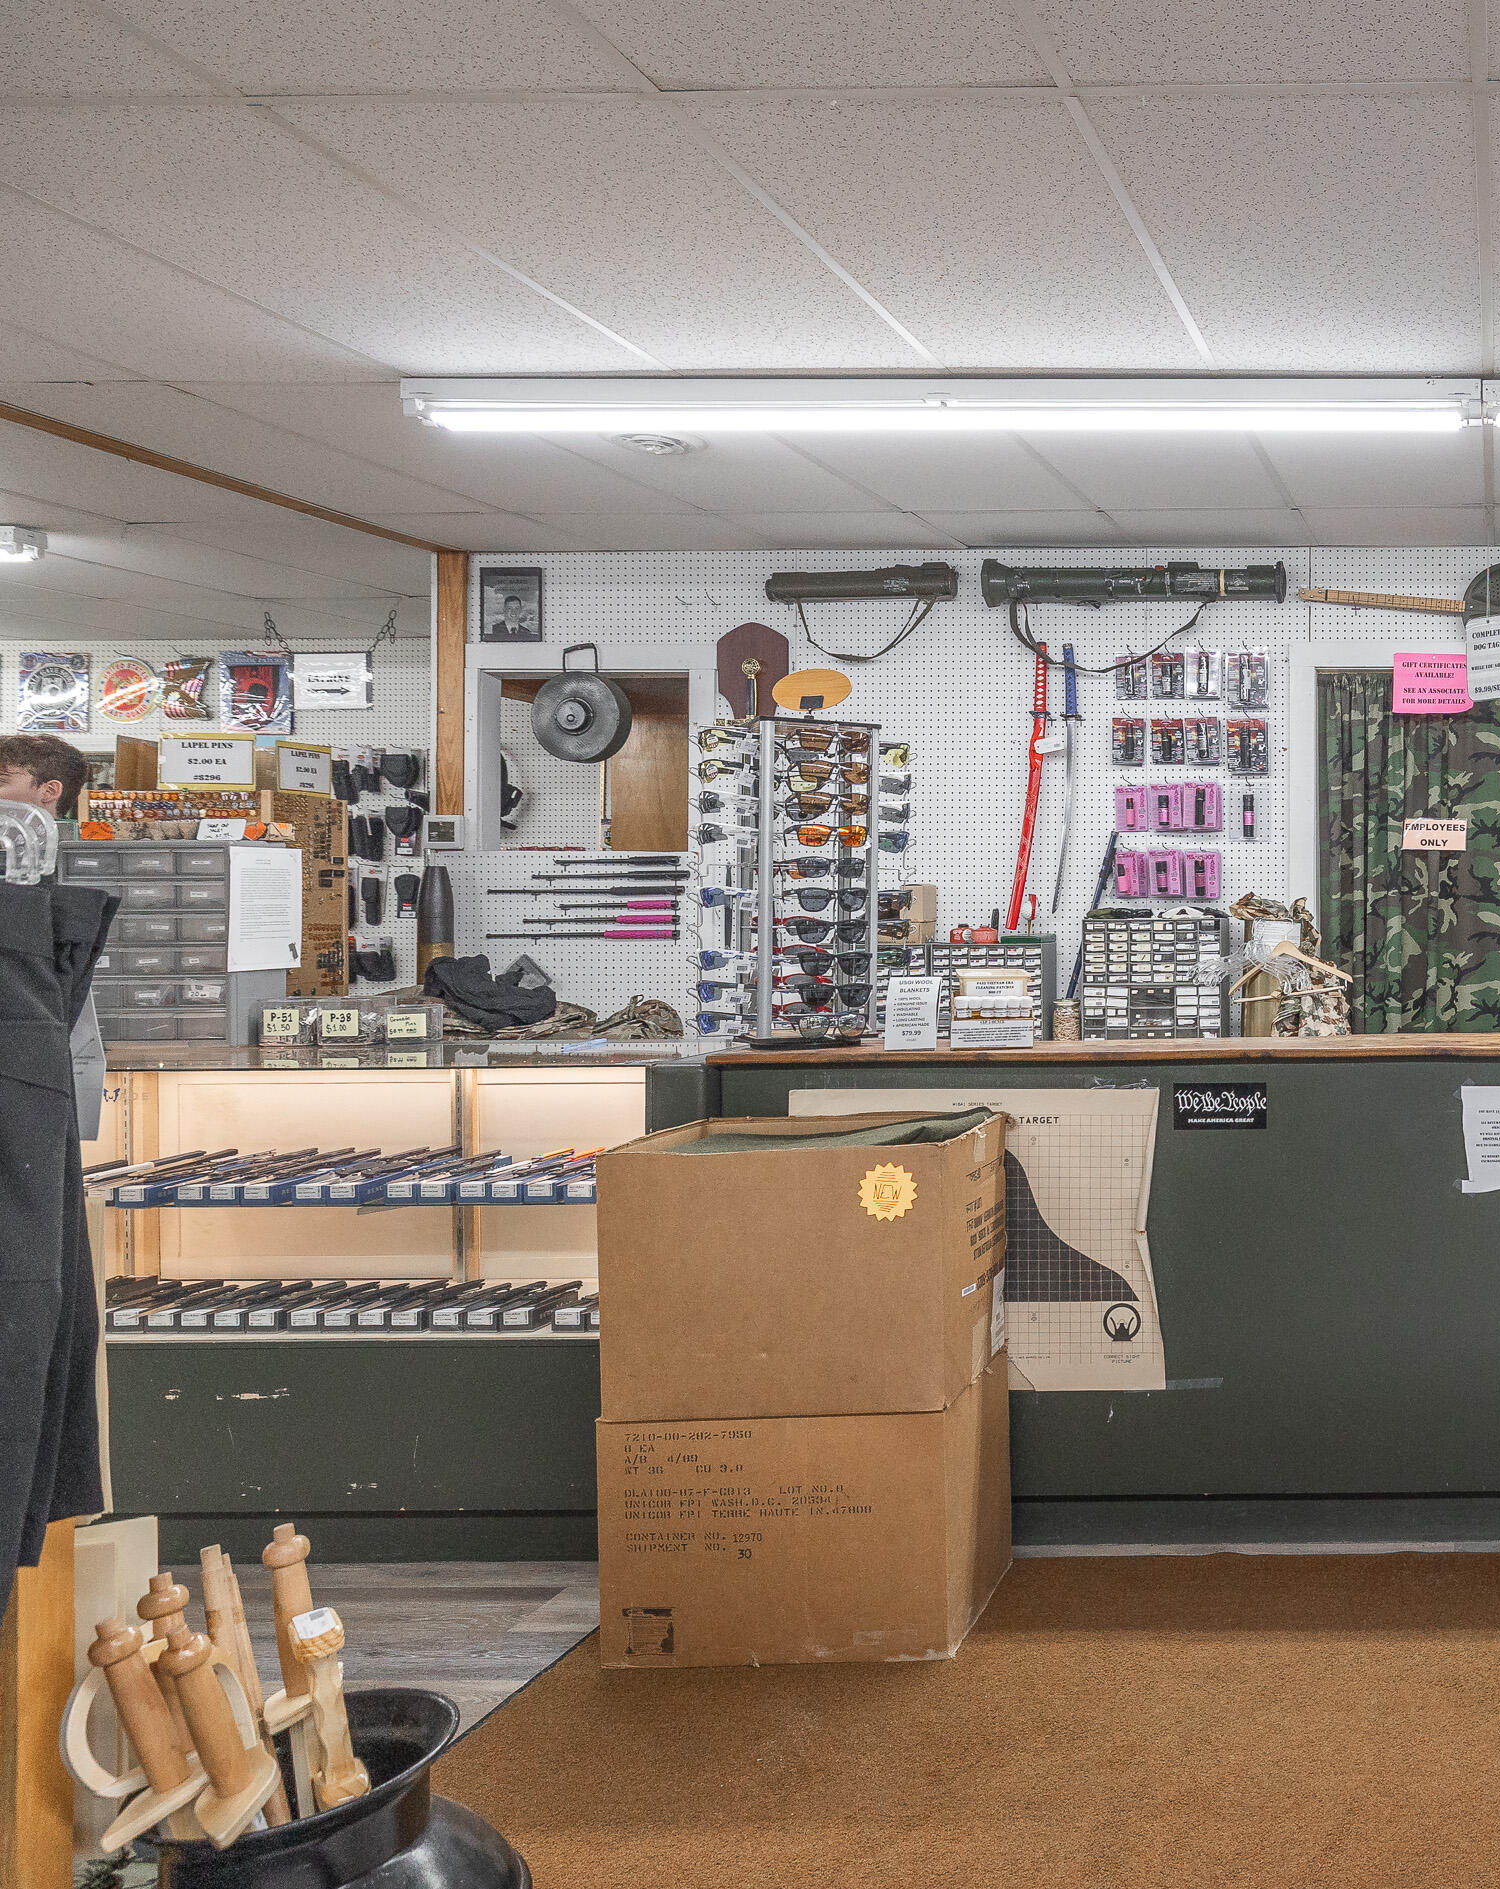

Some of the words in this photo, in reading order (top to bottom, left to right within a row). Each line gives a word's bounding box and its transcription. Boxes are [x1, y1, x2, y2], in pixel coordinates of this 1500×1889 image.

[1474, 643, 1486, 651] DOG
[1405, 823, 1465, 831] EMPLOYEES
[271, 1012, 293, 1023] P-51
[330, 1013, 352, 1023] P-38
[266, 1023, 290, 1033] $1.50
[326, 1024, 346, 1034] $1.00
[873, 1183, 902, 1200] NEW
[640, 1444, 654, 1453] EA
[625, 1466, 639, 1475] WT
[696, 1465, 711, 1473] CU
[780, 1486, 802, 1495] LOT
[625, 1500, 671, 1508] UNICOR
[680, 1499, 701, 1507] FPI
[625, 1511, 671, 1519] UNICOR
[680, 1510, 700, 1519] FPI
[760, 1508, 800, 1517] HAUTE
[626, 1532, 695, 1541] CONTAINER
[704, 1531, 726, 1540] NO.
[733, 1533, 762, 1543] 12970
[626, 1543, 688, 1553] SHIPMENT
[704, 1543, 726, 1551] NO.
[738, 1548, 752, 1560] 30
